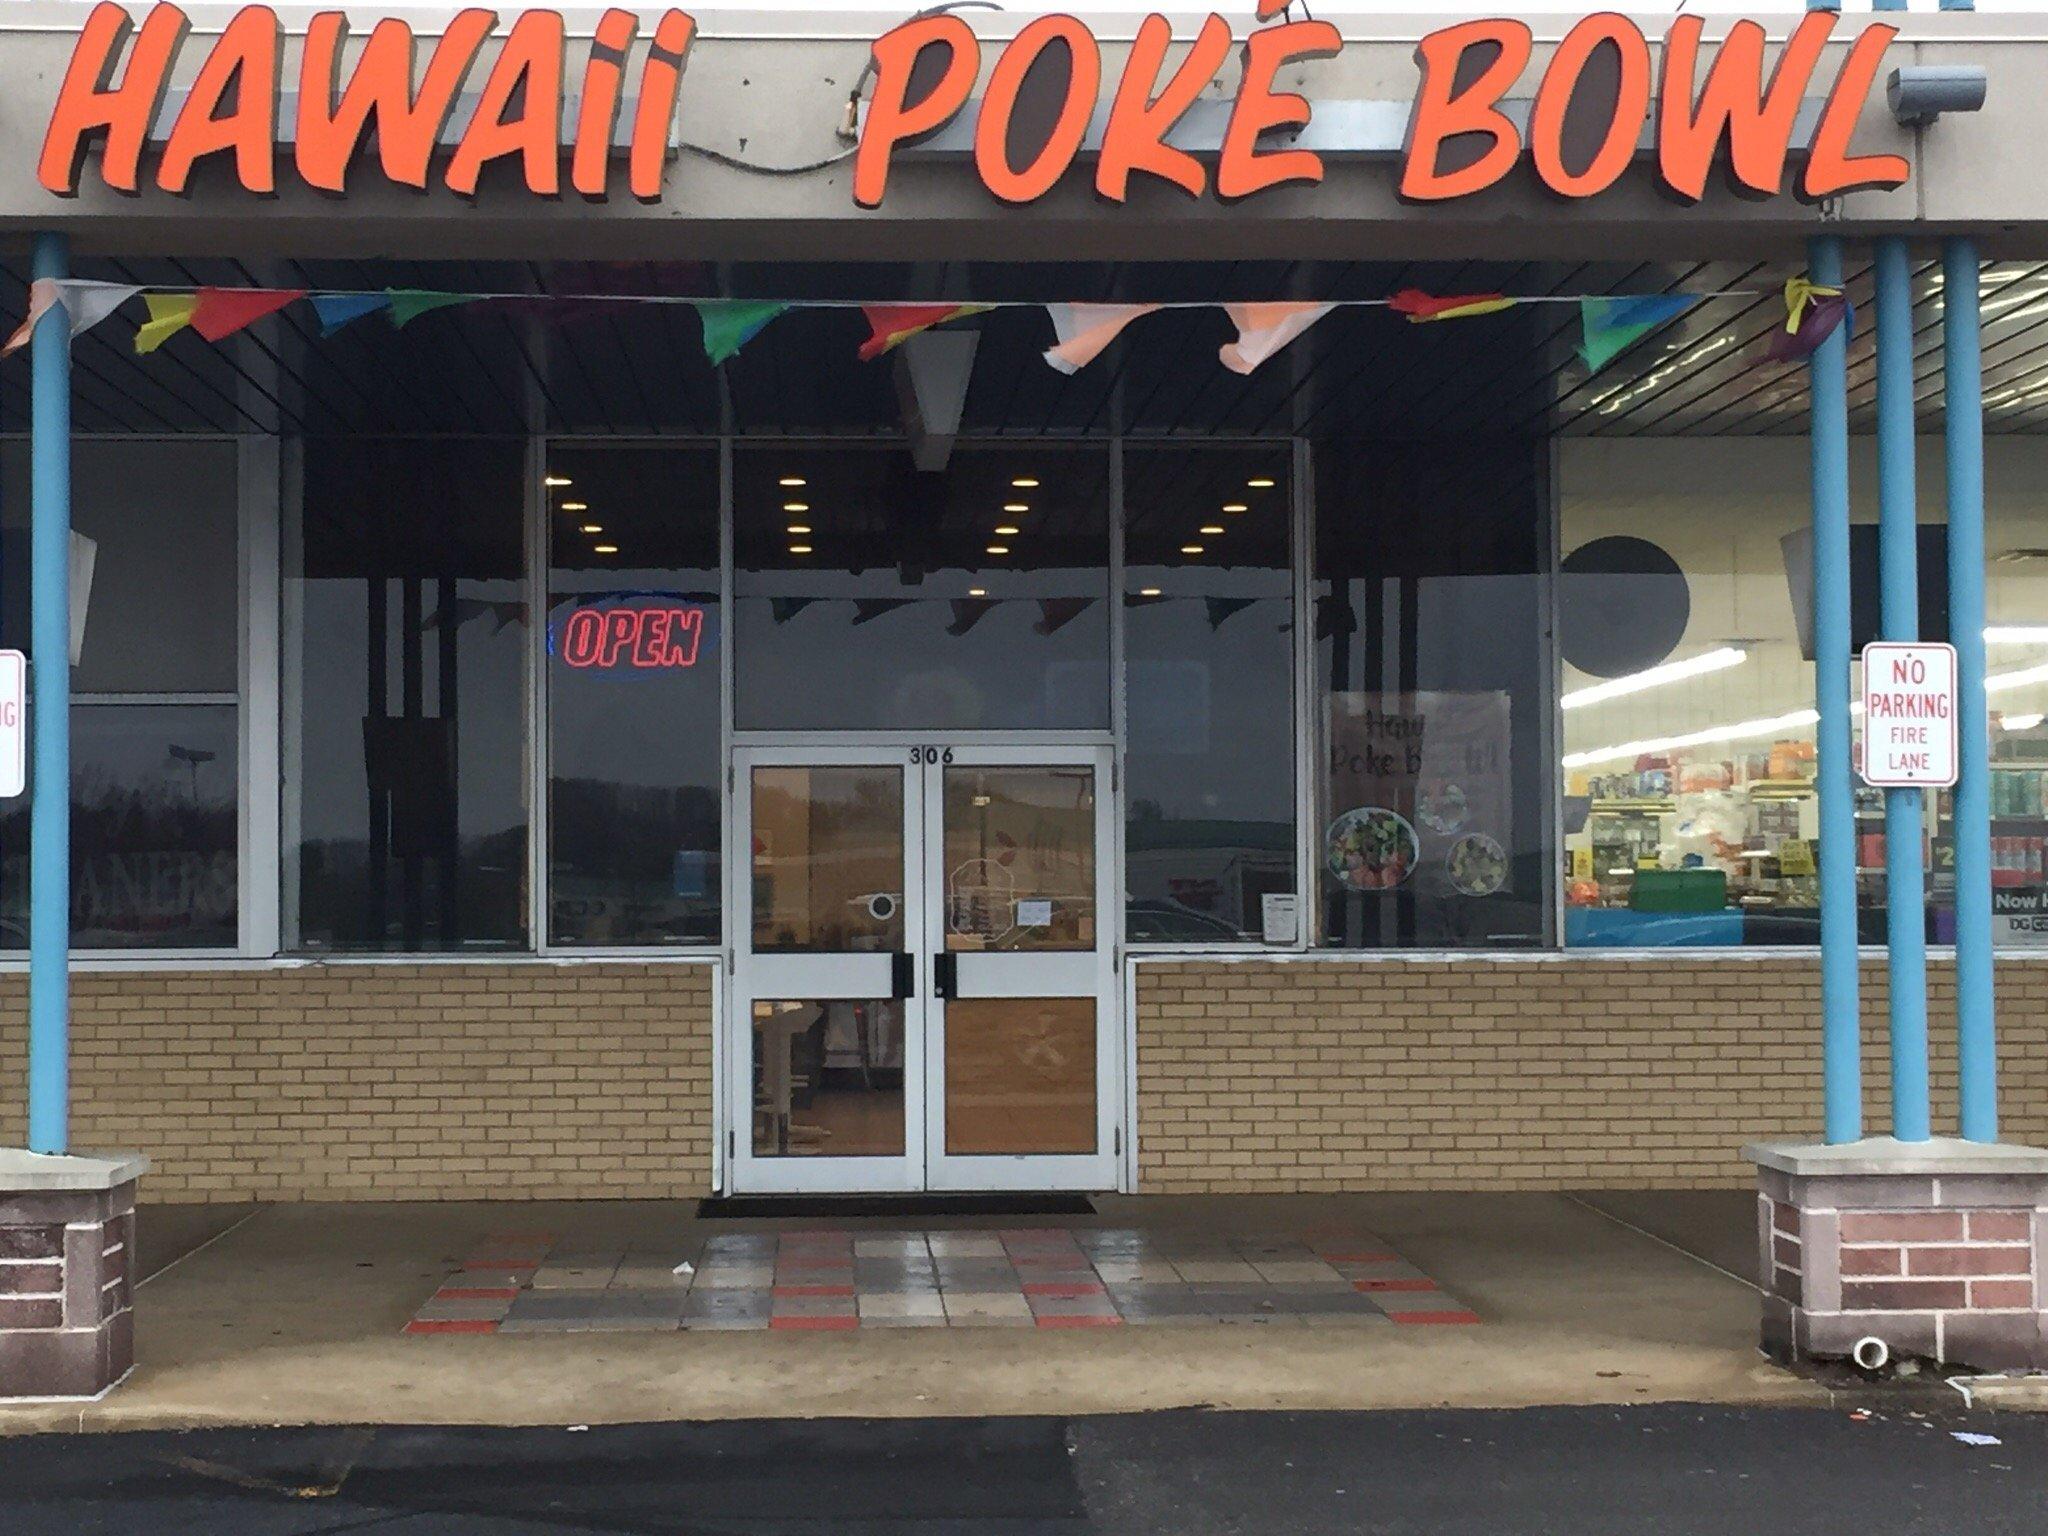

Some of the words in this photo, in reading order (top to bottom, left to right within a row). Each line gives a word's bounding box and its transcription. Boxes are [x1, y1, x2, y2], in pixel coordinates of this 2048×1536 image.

[1402, 13, 1909, 198] BOWL
[564, 608, 704, 668] OPEN
[1893, 659, 1926, 685] NO
[1870, 693, 1948, 719] PARKING
[1890, 726, 1929, 744] FIRE
[910, 746, 954, 765] 306
[1888, 753, 1931, 770] LANE
